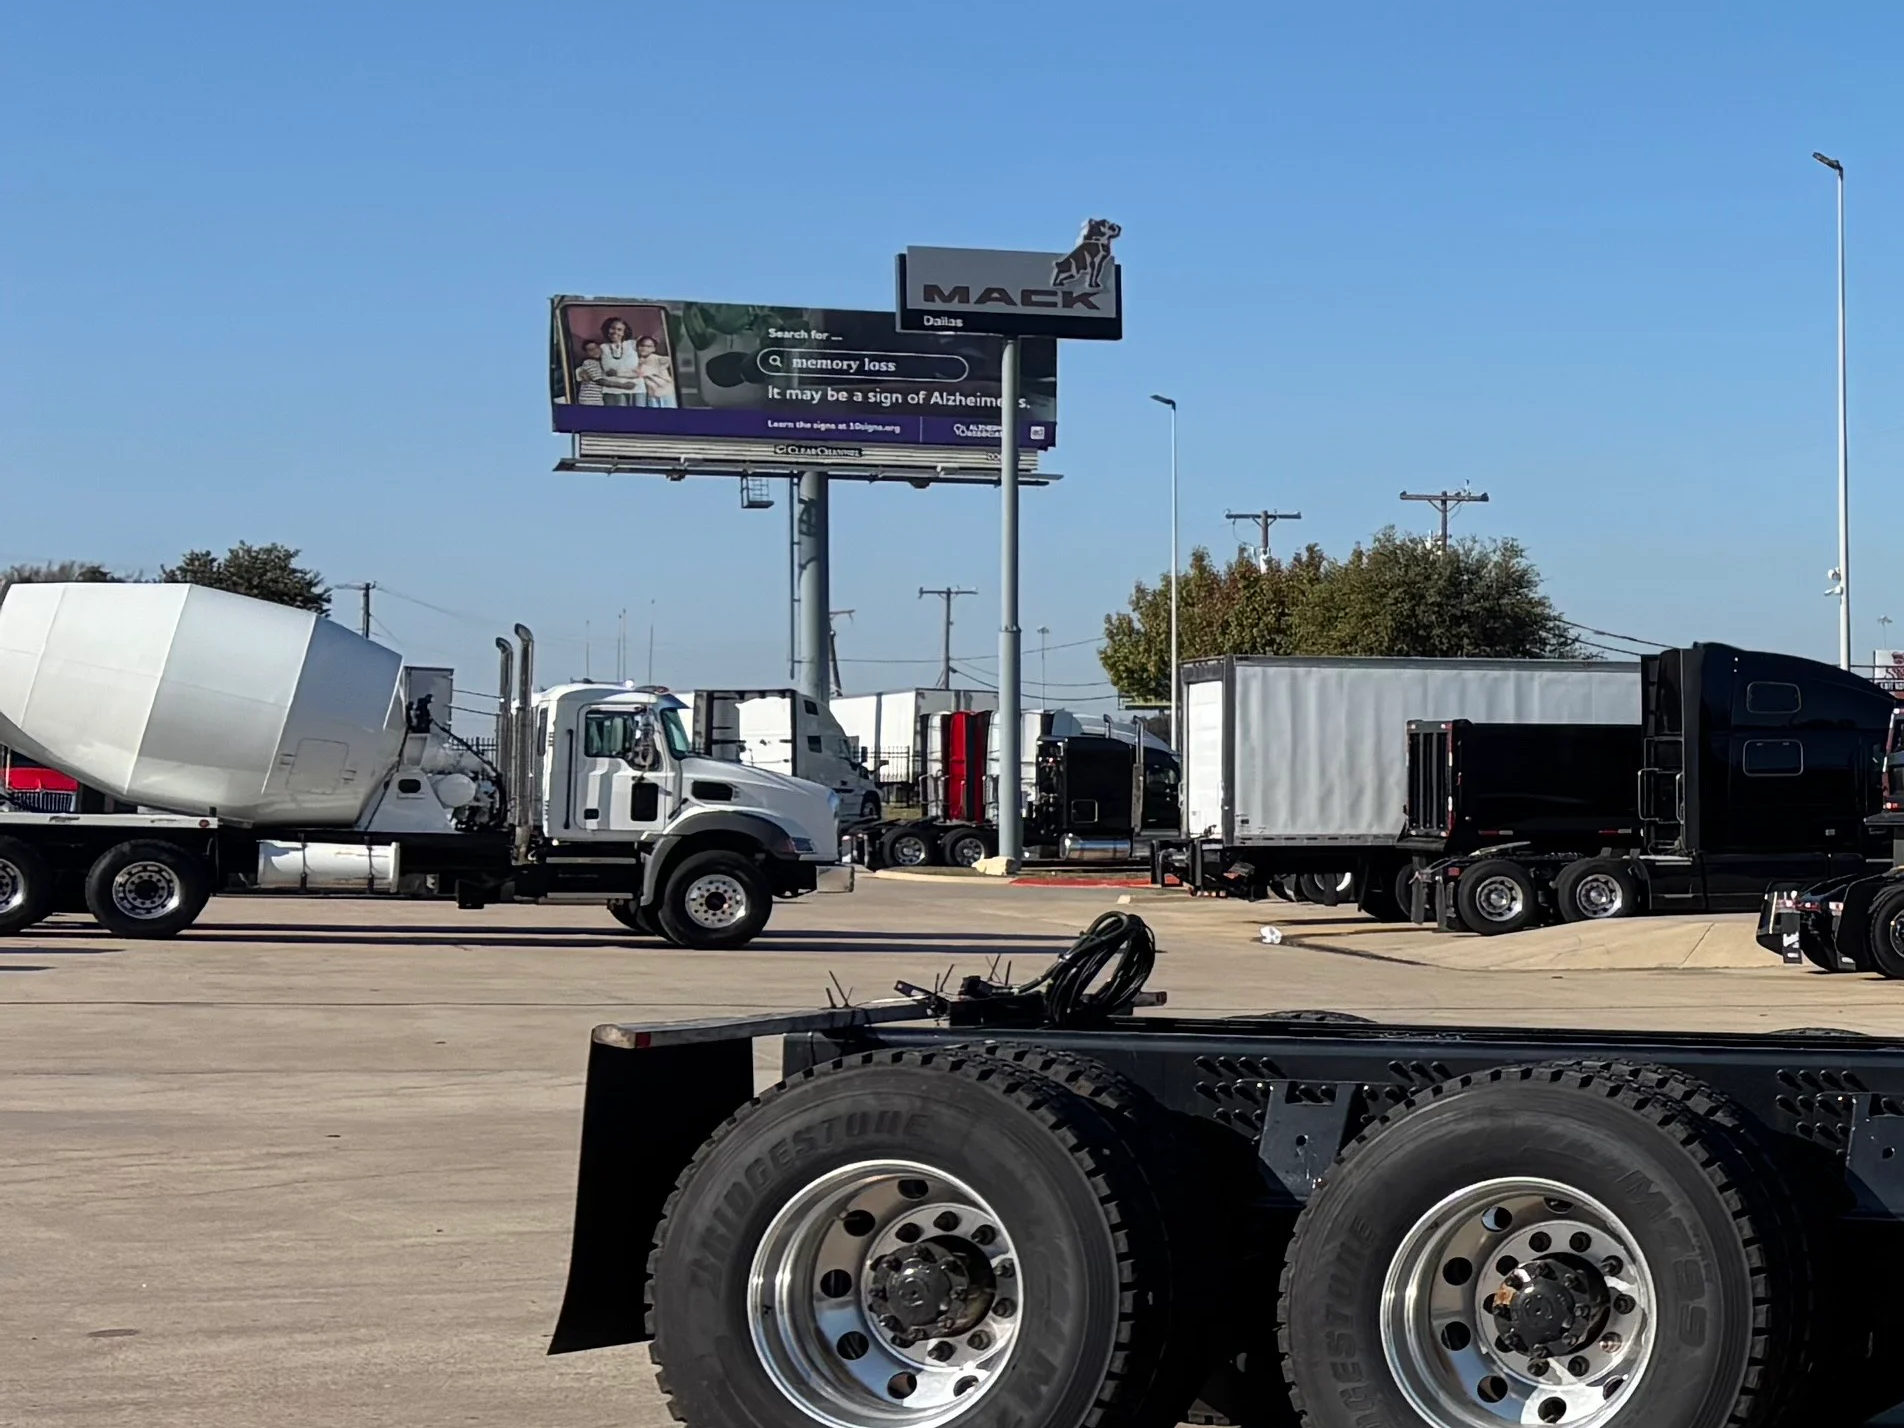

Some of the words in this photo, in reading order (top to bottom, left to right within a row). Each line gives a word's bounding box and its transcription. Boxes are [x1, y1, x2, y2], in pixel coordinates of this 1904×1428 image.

[923, 284, 1101, 310] MACK
[923, 315, 964, 327] Dallas
[768, 328, 808, 339] Search
[811, 330, 829, 340] for
[792, 358, 859, 372] memory
[864, 357, 897, 371] loss
[768, 386, 781, 399] It
[786, 389, 822, 404] may
[827, 387, 849, 402] be
[853, 391, 862, 402] a
[868, 388, 902, 406] sign
[907, 390, 928, 405] of
[767, 420, 794, 429] Learn
[796, 420, 811, 429] the
[813, 420, 836, 431] signs
[838, 421, 847, 430] at
[689, 1111, 935, 1299] BRIDGESTONE
